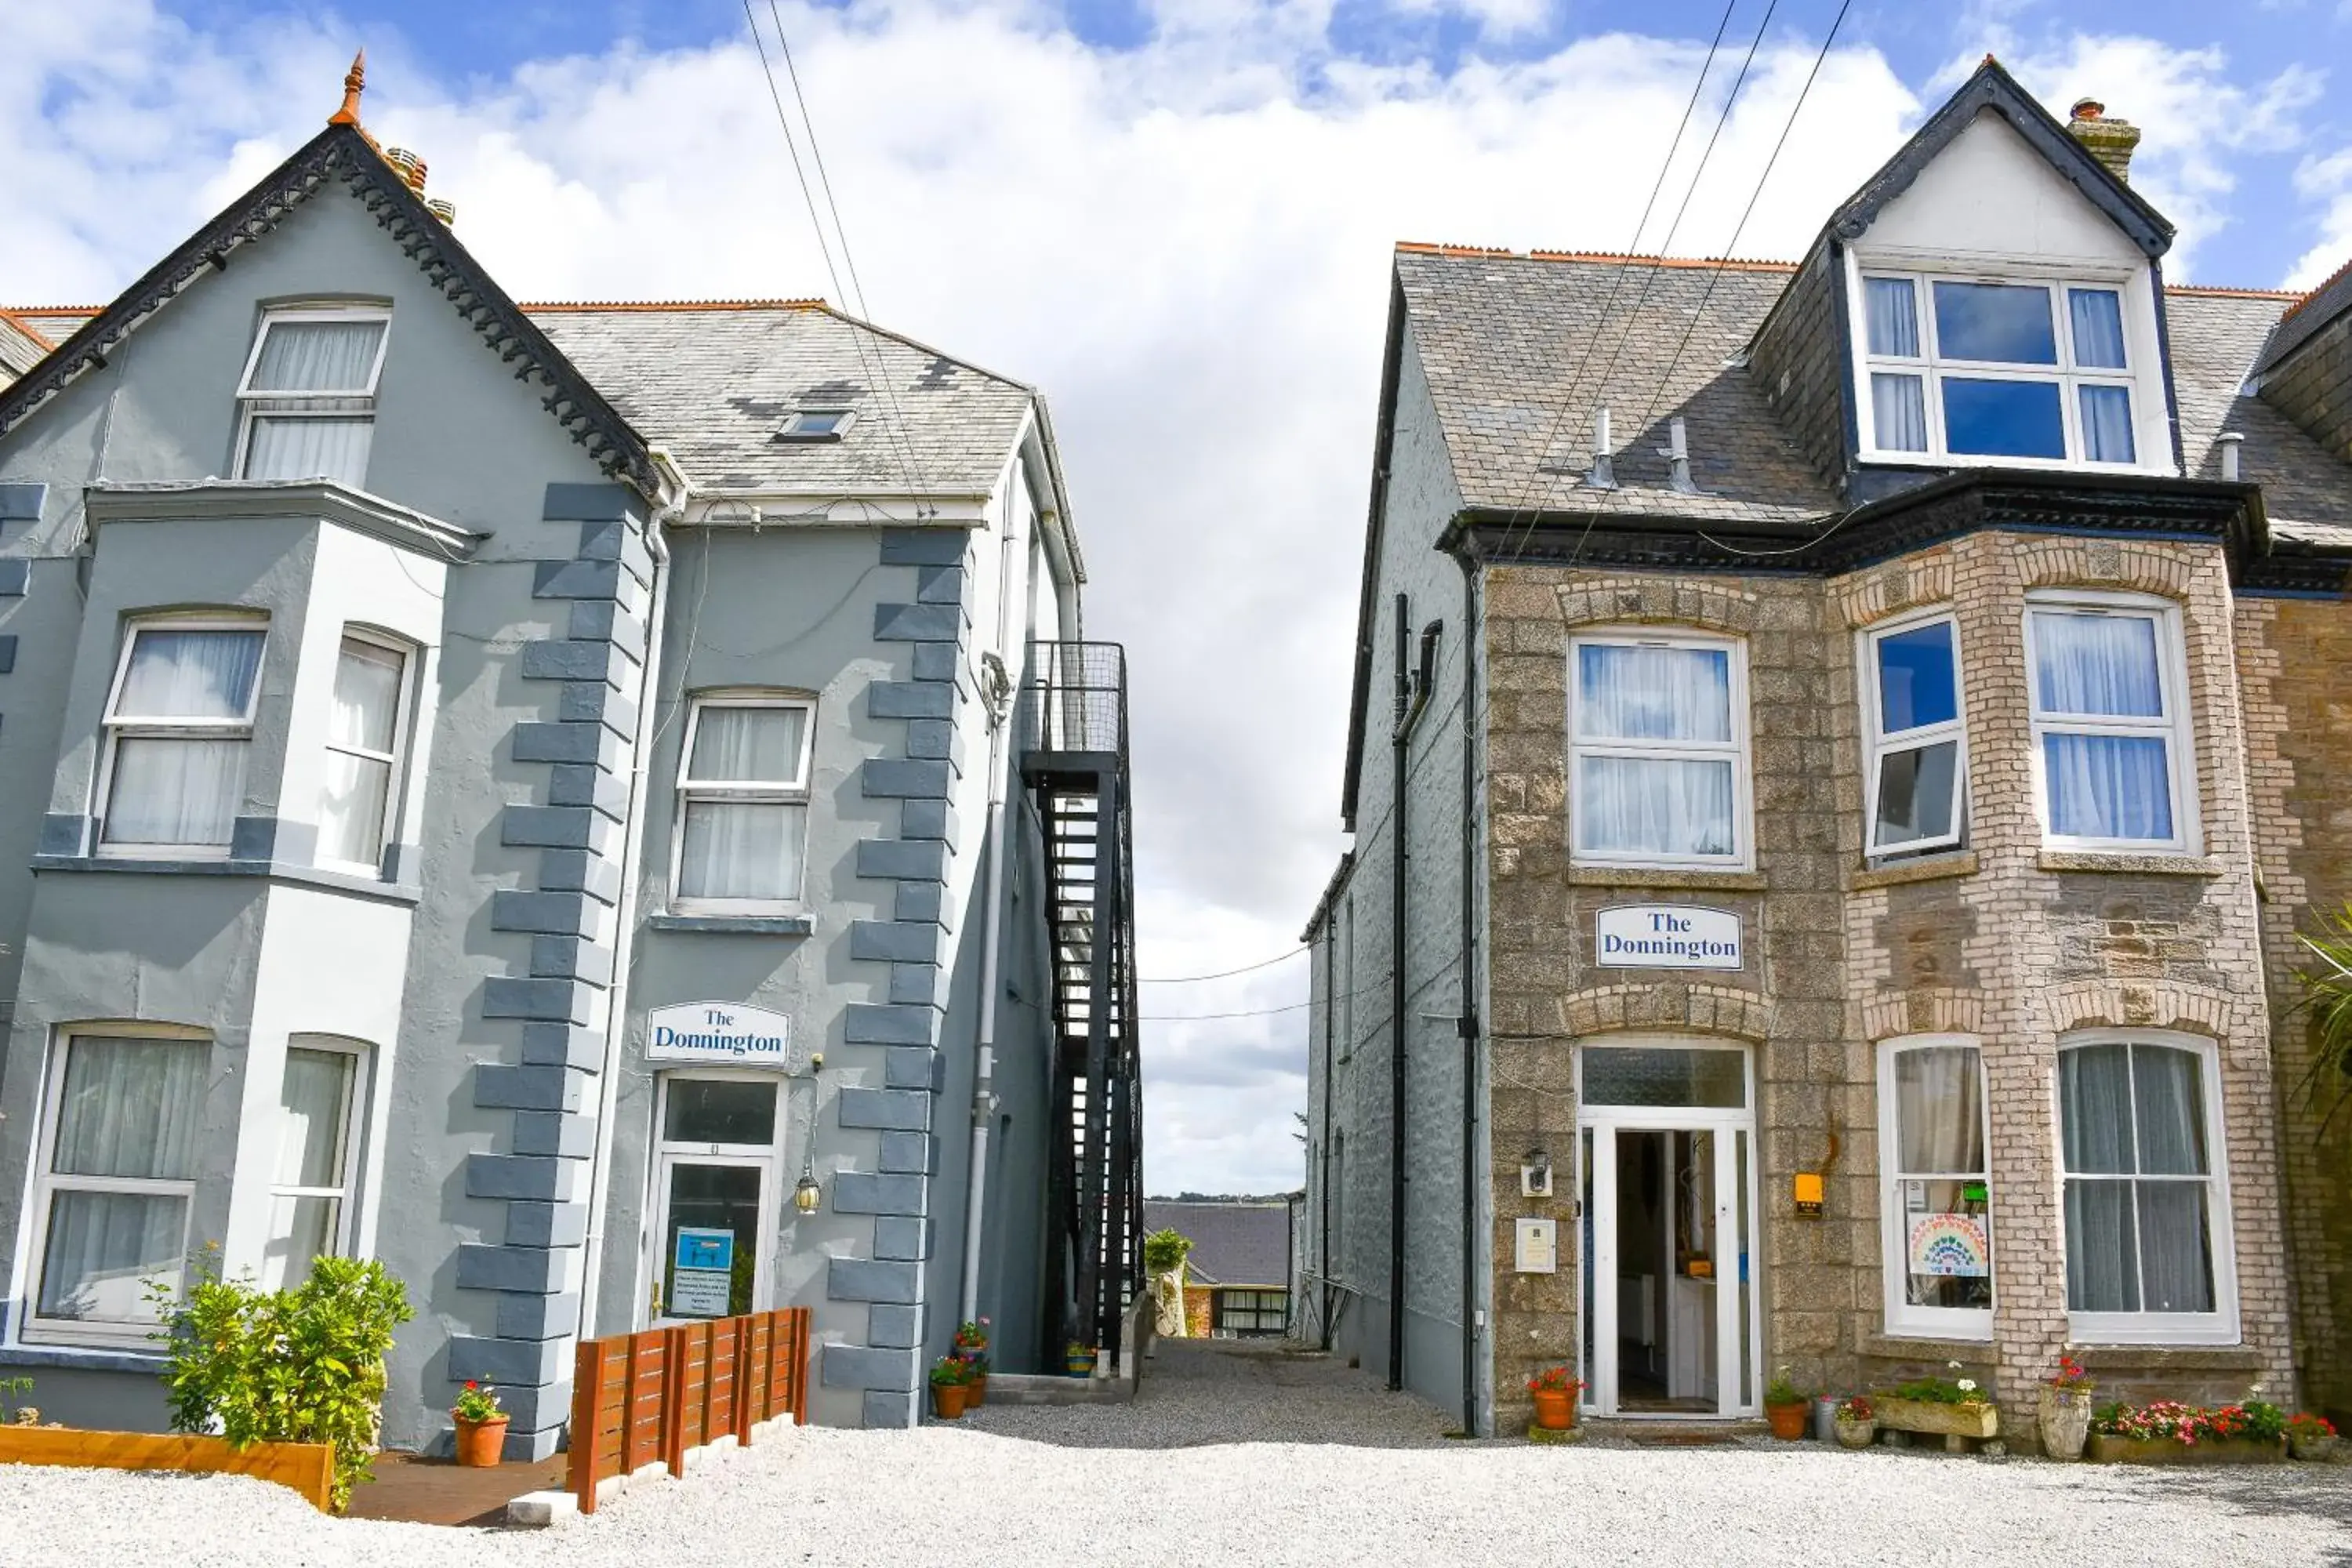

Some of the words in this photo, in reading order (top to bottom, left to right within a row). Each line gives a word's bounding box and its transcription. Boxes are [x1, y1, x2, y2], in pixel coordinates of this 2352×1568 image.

[1648, 913, 1691, 931] The
[1605, 935, 1736, 960] Donnington
[704, 1009, 734, 1026] The
[655, 1026, 781, 1055] Donnington
